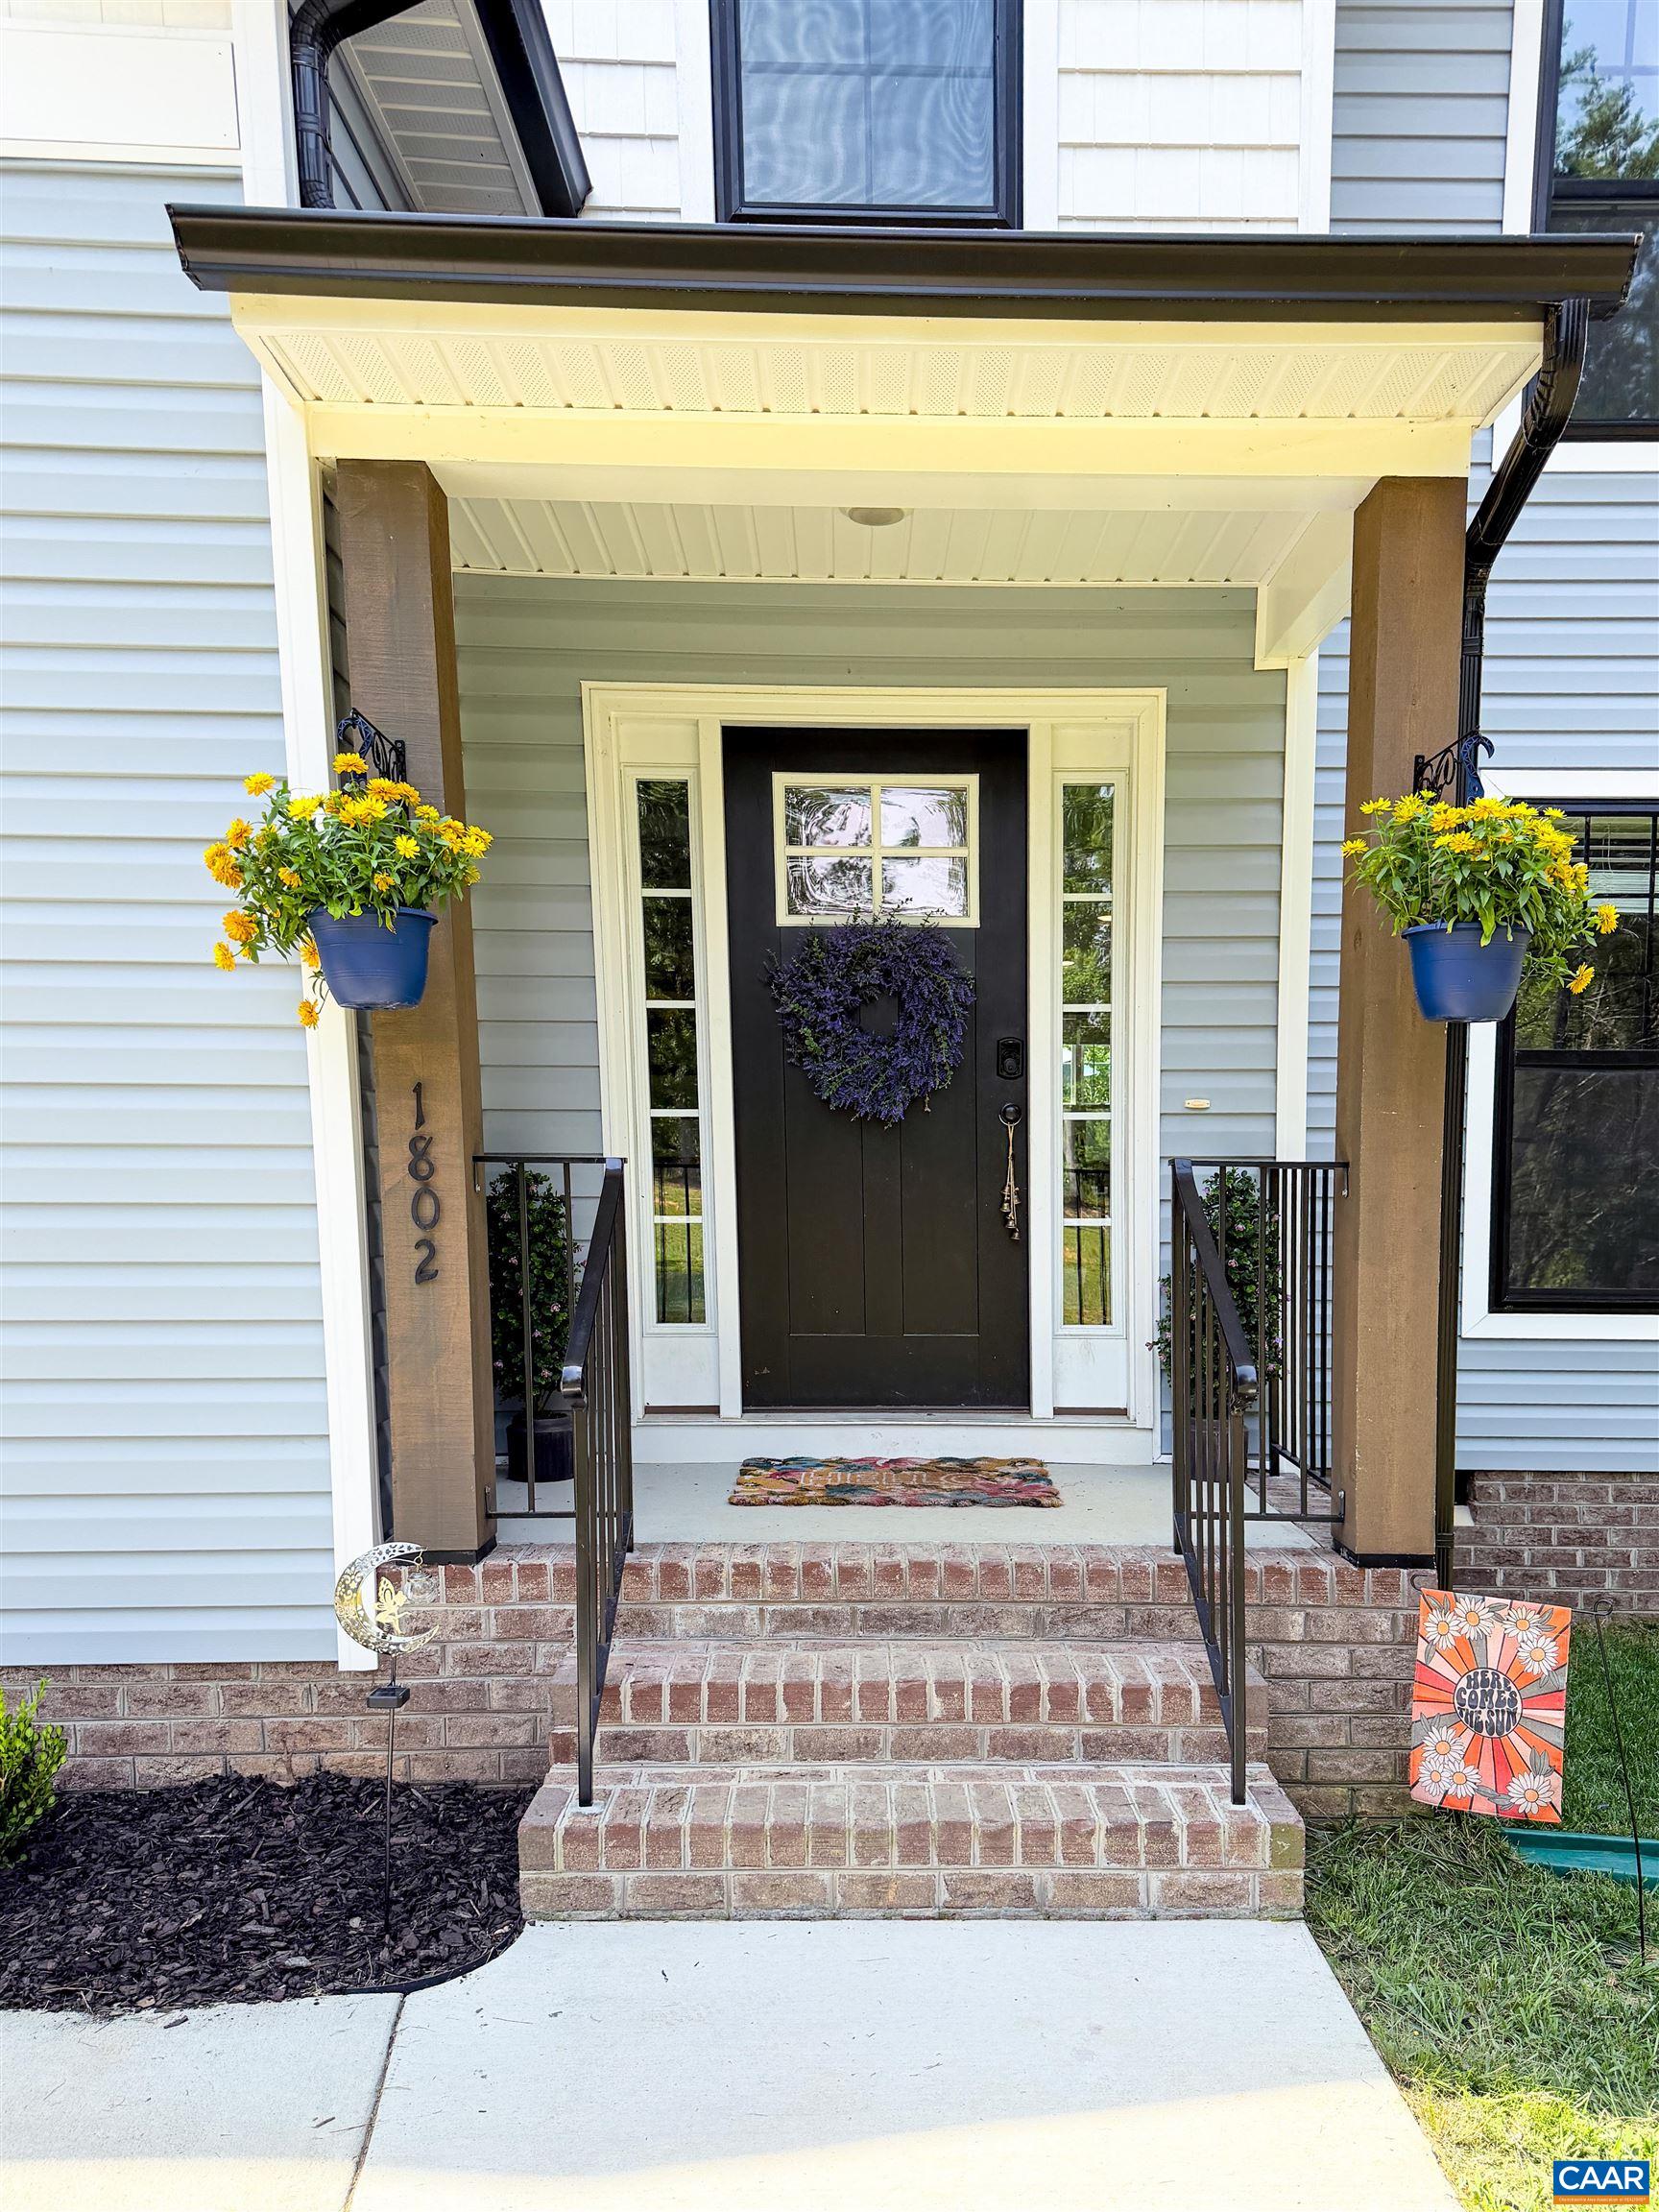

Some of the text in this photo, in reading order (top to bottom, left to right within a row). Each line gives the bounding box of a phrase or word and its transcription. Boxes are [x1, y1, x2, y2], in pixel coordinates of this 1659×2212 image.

[408, 1081, 440, 1285] 1802
[1466, 1670, 1511, 1692] HERE
[1455, 1687, 1518, 1709] COMES
[1457, 1706, 1518, 1736] THE SUN
